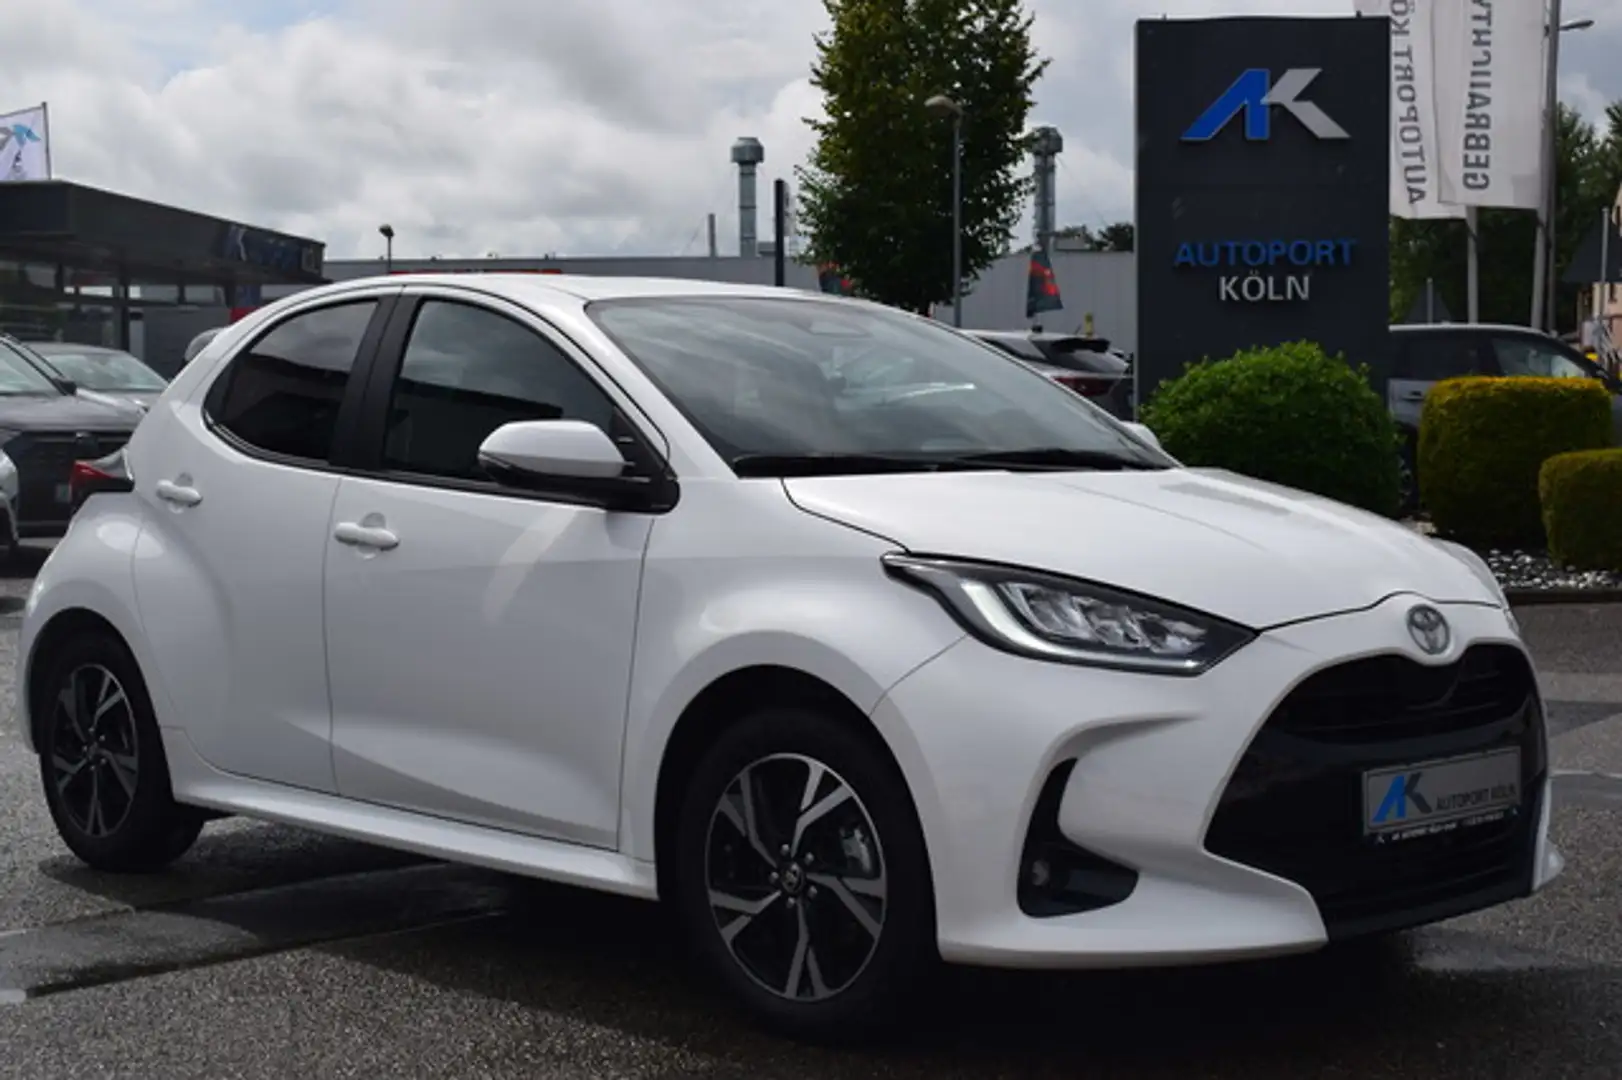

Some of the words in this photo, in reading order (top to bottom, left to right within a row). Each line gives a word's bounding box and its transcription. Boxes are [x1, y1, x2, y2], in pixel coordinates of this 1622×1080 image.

[1180, 67, 1352, 141] AK
[1173, 238, 1357, 269] AUTOPORT
[1219, 271, 1311, 302] KÖLN
